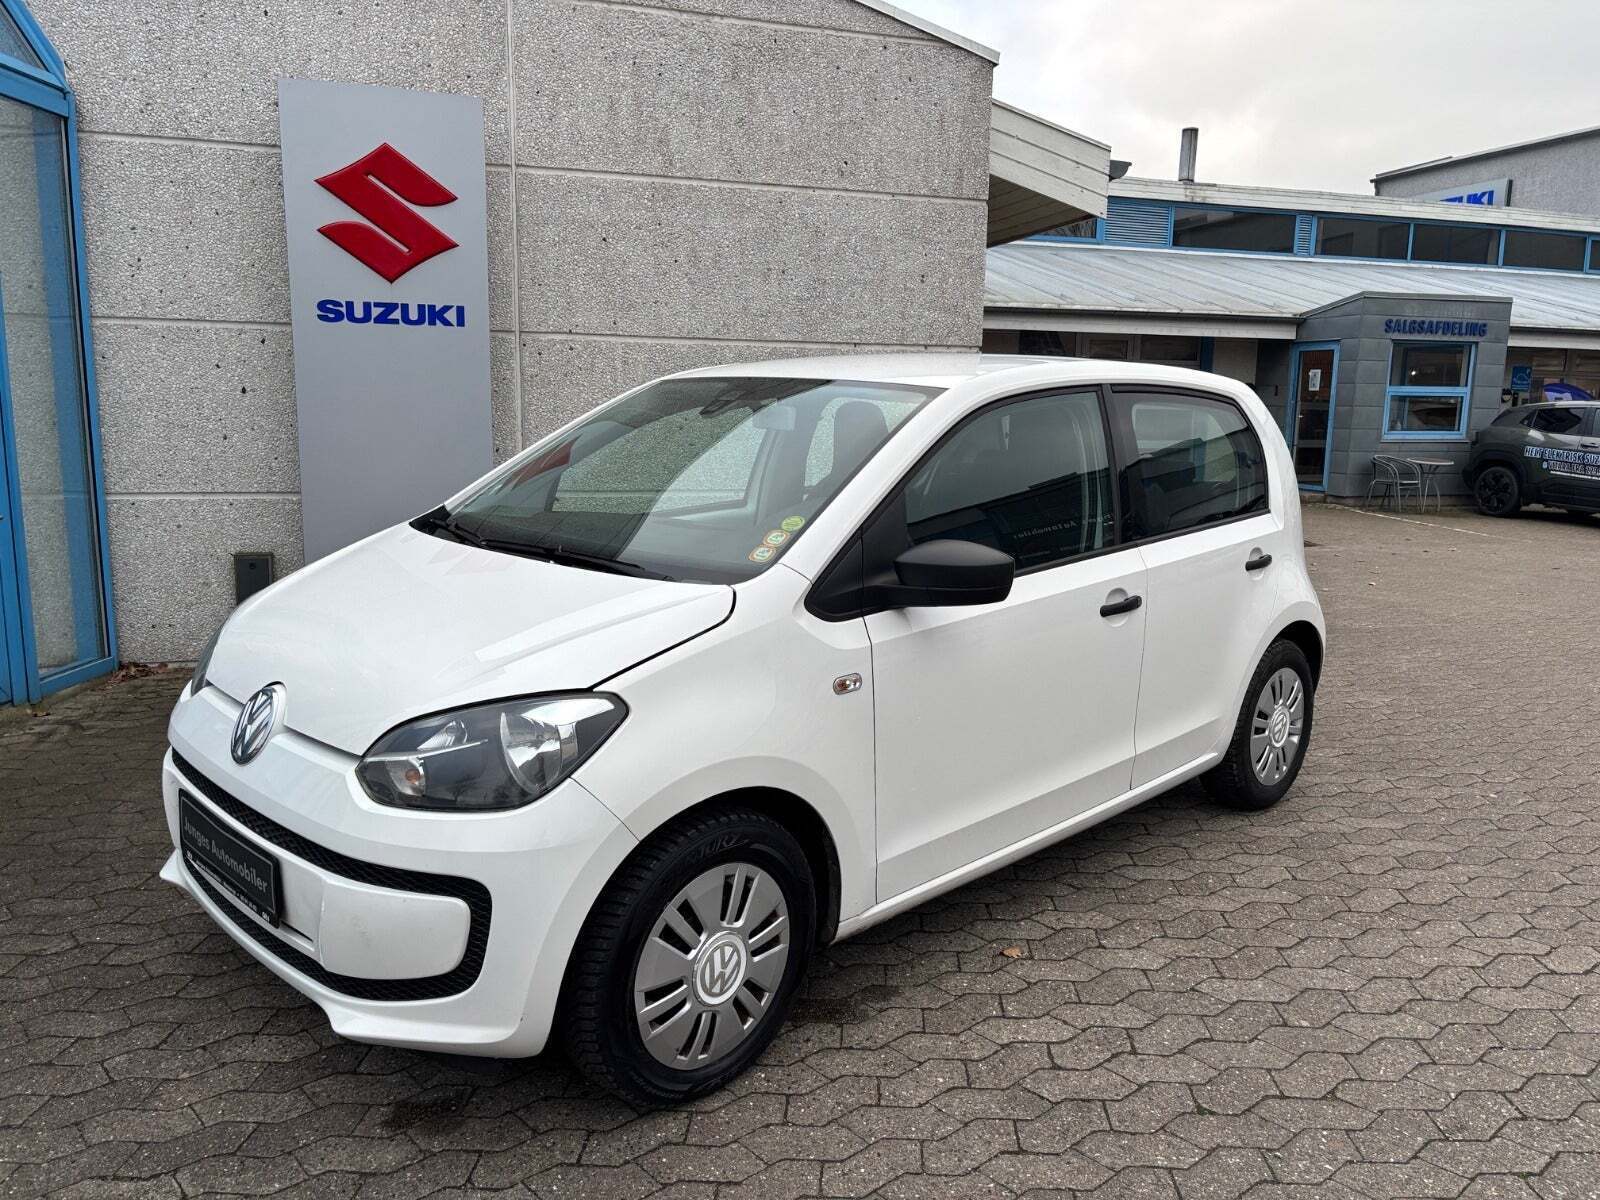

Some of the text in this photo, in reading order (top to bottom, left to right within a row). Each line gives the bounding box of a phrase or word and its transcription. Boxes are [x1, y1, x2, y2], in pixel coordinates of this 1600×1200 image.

[316, 299, 464, 327] SUZUKI
[1384, 319, 1488, 337] SALGSAFDELING
[1543, 448, 1583, 463] ELEKTRISK
[212, 839, 268, 893] Automobiler
